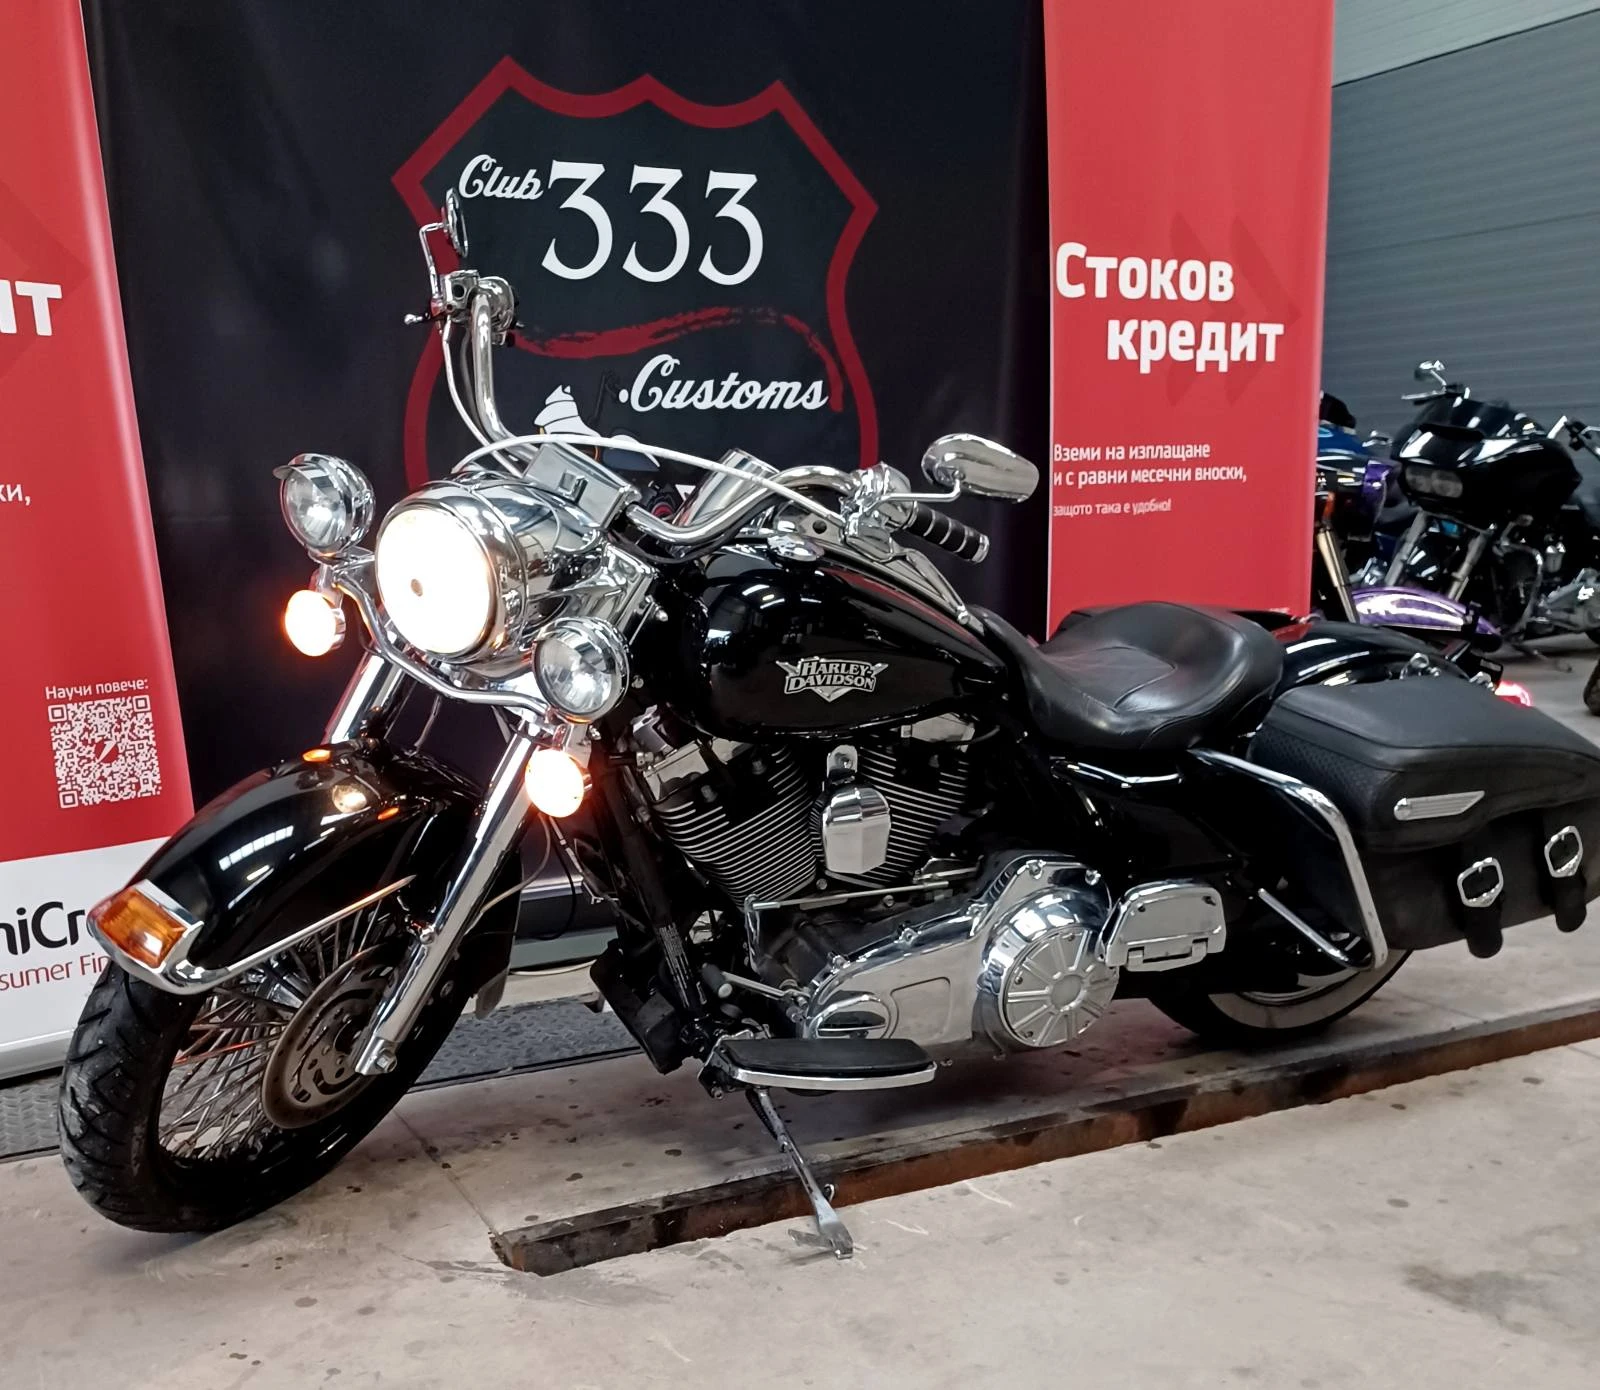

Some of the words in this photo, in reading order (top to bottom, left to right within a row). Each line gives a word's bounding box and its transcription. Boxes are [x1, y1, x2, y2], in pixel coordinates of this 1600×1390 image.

[458, 154, 544, 200] Club
[541, 160, 764, 286] 333
[1056, 242, 1234, 302] Стоков
[1107, 319, 1284, 374] кредит
[630, 354, 828, 413] Customs
[1054, 443, 1101, 462] Вземи
[1105, 445, 1125, 460] на
[1128, 443, 1211, 461] изплащане
[1053, 471, 1062, 486] и
[1065, 471, 1074, 486] с
[1078, 470, 1127, 489] равни
[1130, 467, 1192, 483] месечни
[1195, 465, 1247, 482] вноски,
[1053, 503, 1092, 518] защото
[1096, 501, 1121, 515] така
[1123, 501, 1131, 513] е
[1132, 498, 1171, 515] удобно!
[801, 660, 873, 677] HARLEY-
[45, 685, 93, 701] Научи
[96, 678, 149, 695] повече:
[787, 674, 875, 691] DAVIDSON
